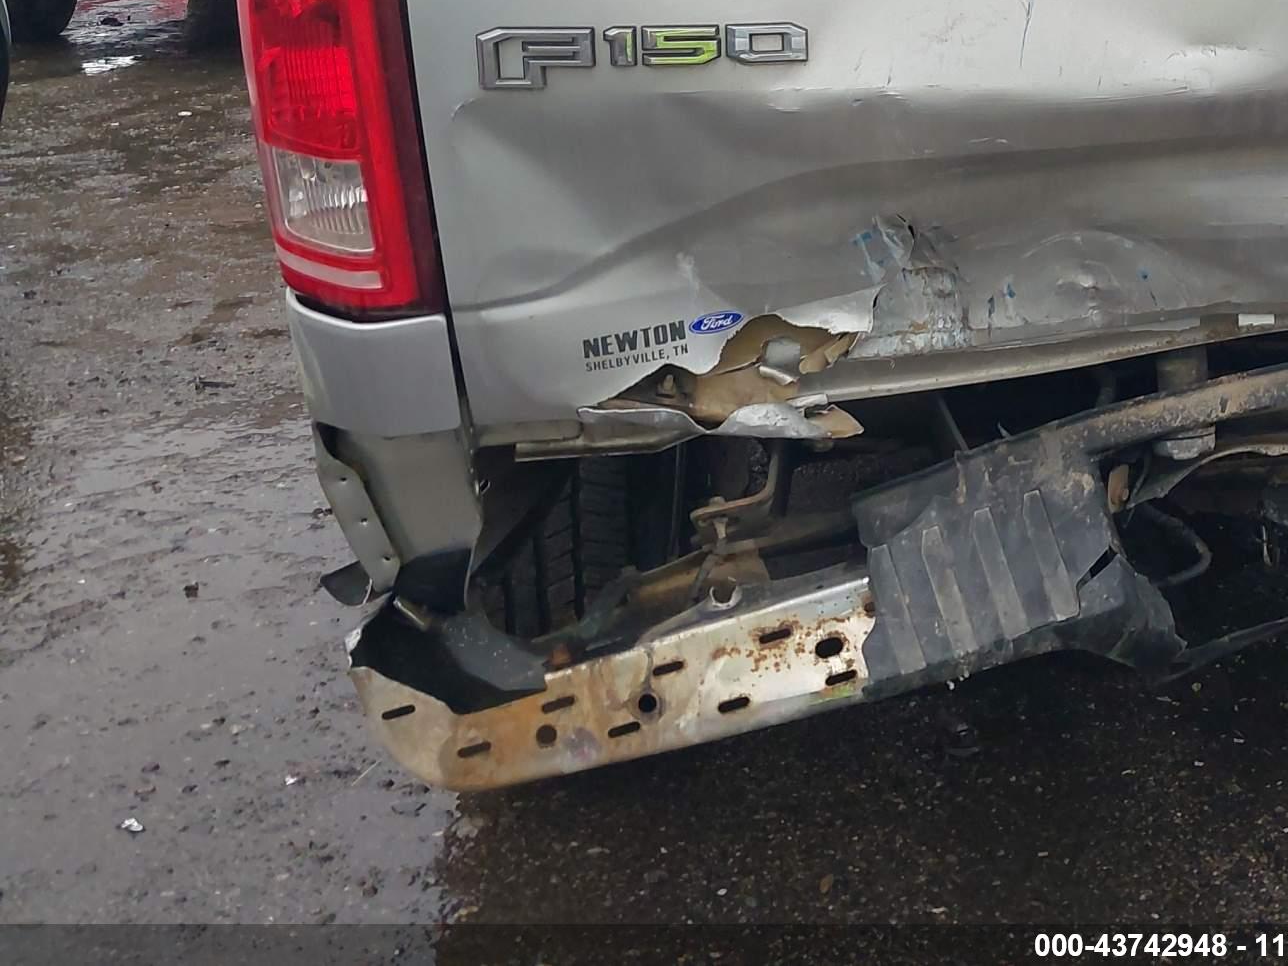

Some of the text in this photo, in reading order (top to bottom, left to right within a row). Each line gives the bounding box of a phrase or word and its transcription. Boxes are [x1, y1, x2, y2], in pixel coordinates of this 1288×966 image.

[583, 314, 734, 358] NEWTON Ford
[585, 344, 688, 372] SHELBYVILLE, TN
